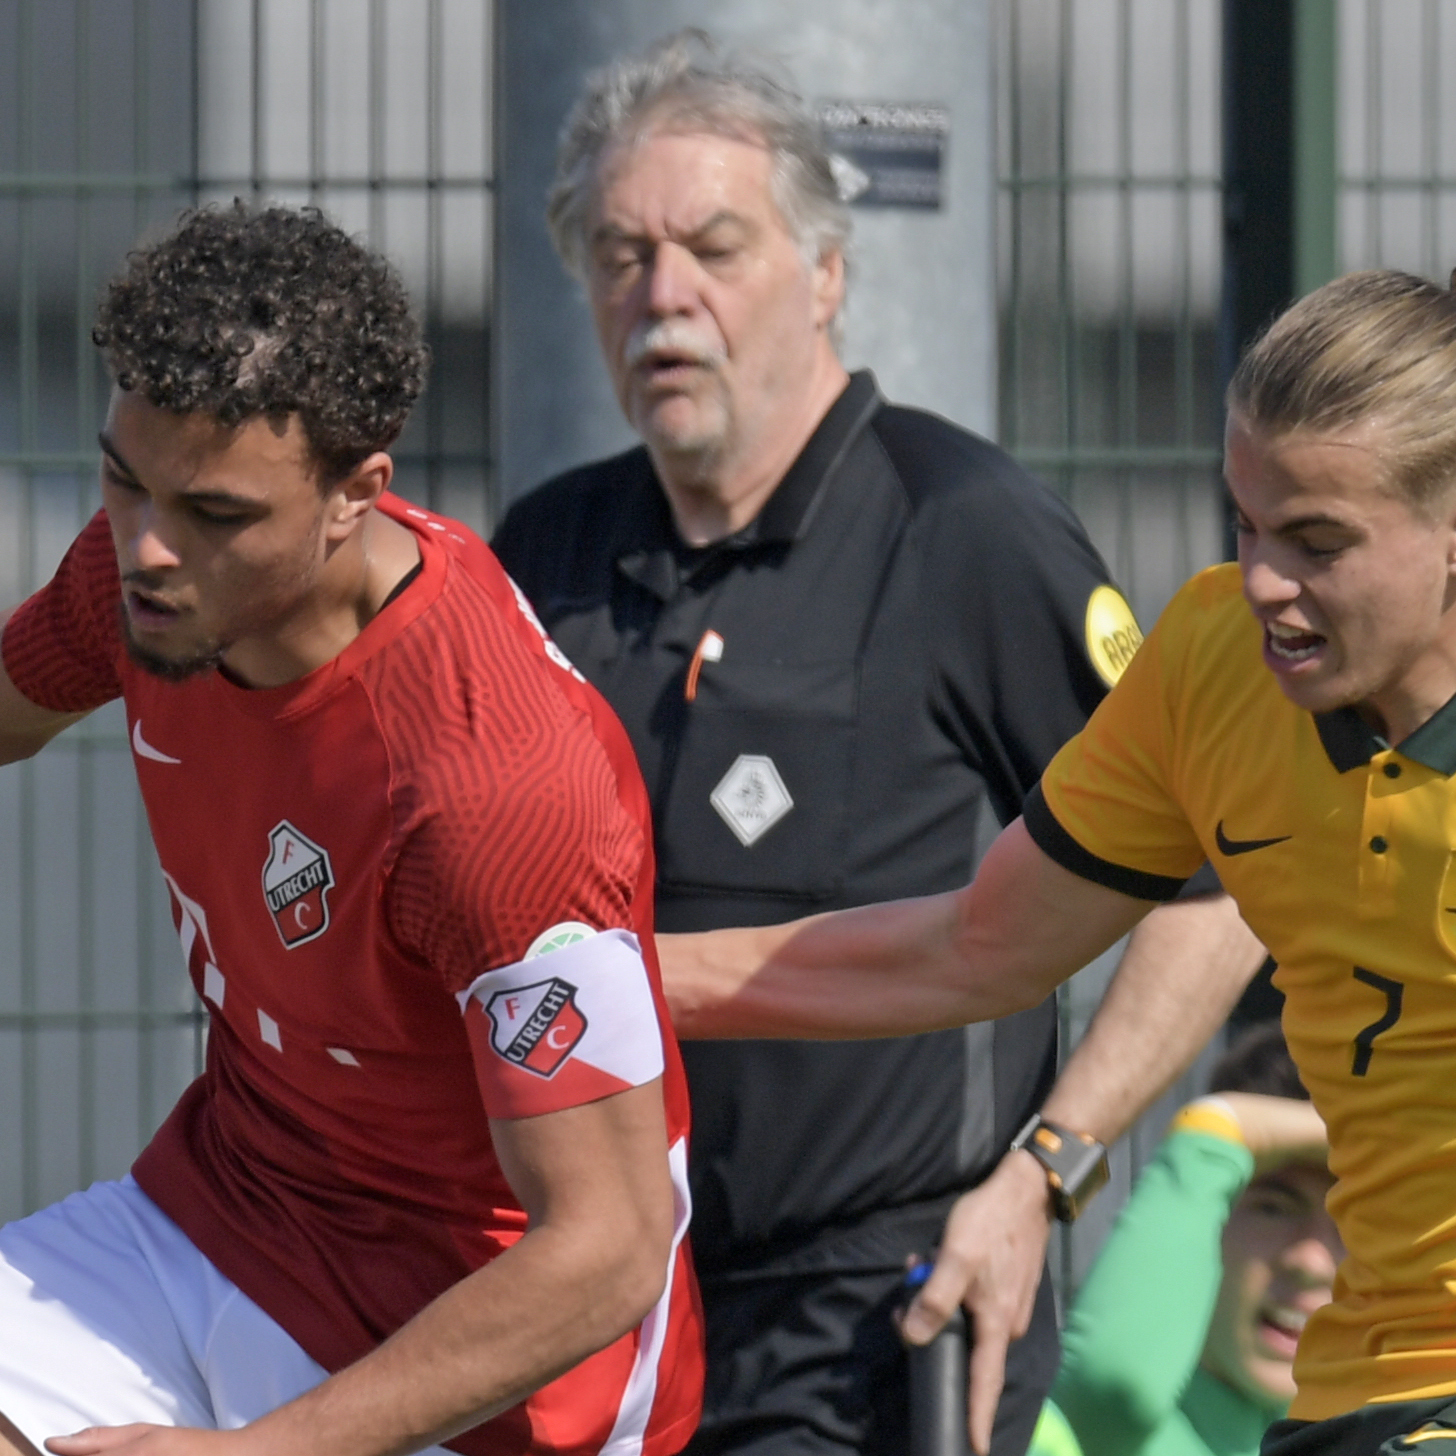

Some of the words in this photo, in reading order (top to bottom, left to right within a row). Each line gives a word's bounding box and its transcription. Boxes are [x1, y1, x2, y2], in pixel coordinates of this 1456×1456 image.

[282, 839, 295, 865] F
[267, 861, 325, 912] UTRECHT
[294, 901, 311, 931] C
[504, 997, 521, 1021] F
[506, 982, 570, 1063] UTRECHT
[1351, 965, 1404, 1077] 7
[547, 1025, 570, 1050] C
